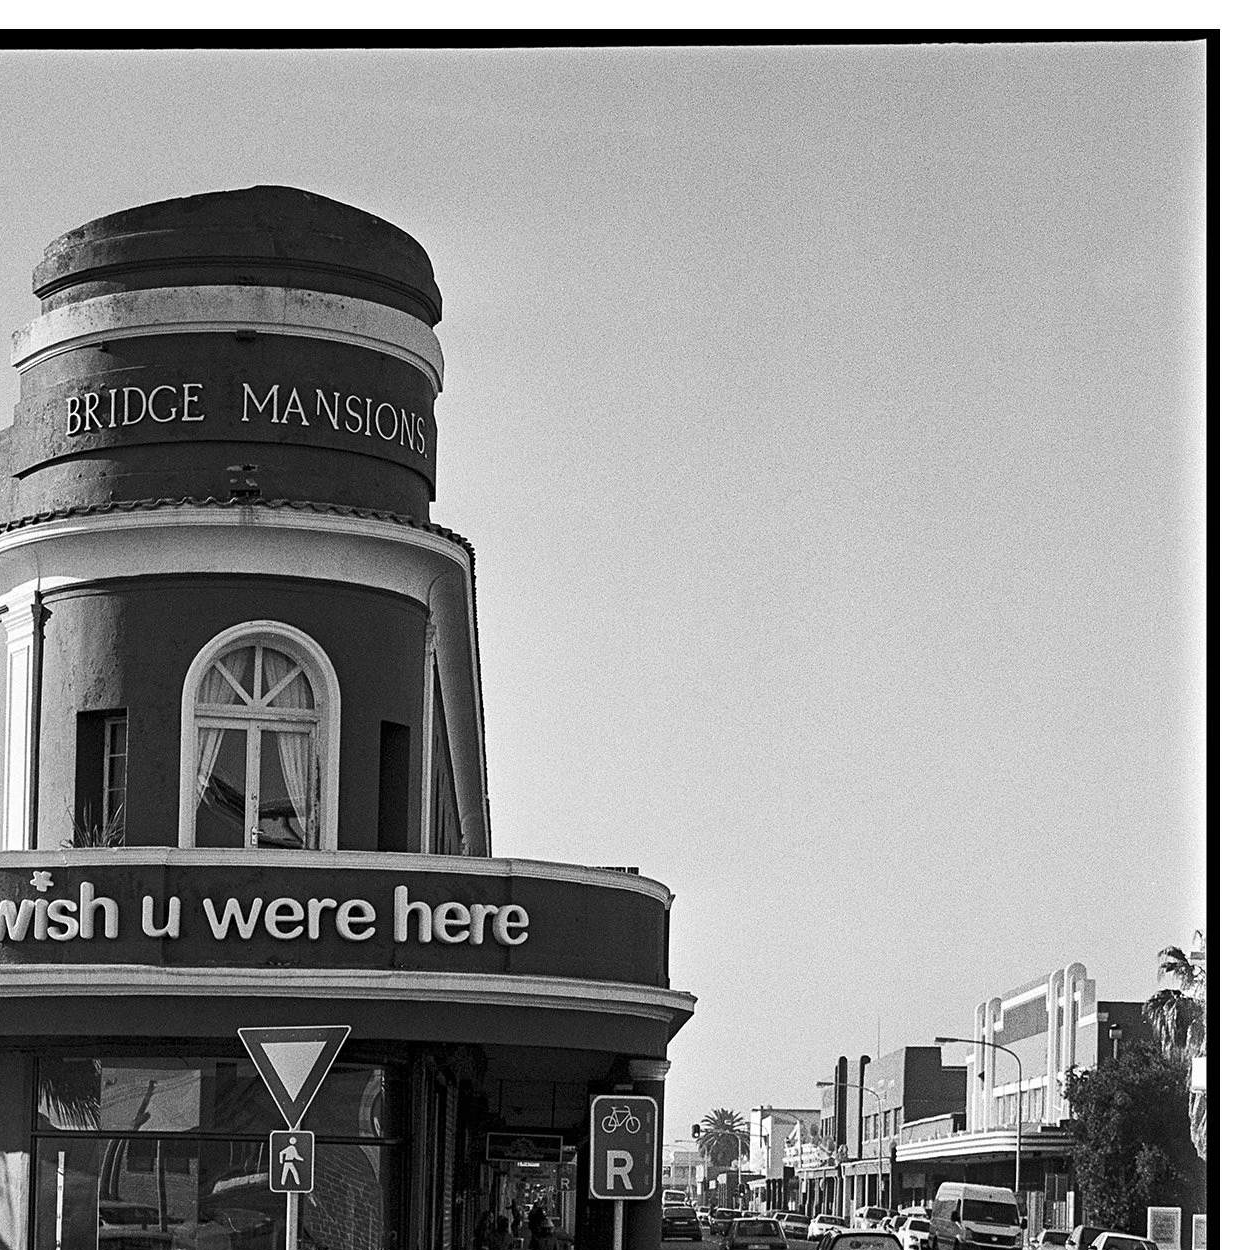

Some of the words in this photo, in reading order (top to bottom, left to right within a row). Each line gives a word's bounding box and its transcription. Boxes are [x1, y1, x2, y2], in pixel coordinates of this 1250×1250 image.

[65, 383, 205, 438] BRIDGE
[241, 383, 428, 459] MANSIONS.
[142, 894, 181, 938] u
[203, 894, 377, 943] were
[394, 885, 530, 946] here
[560, 1178, 570, 1190] R
[606, 1150, 634, 1190] R
